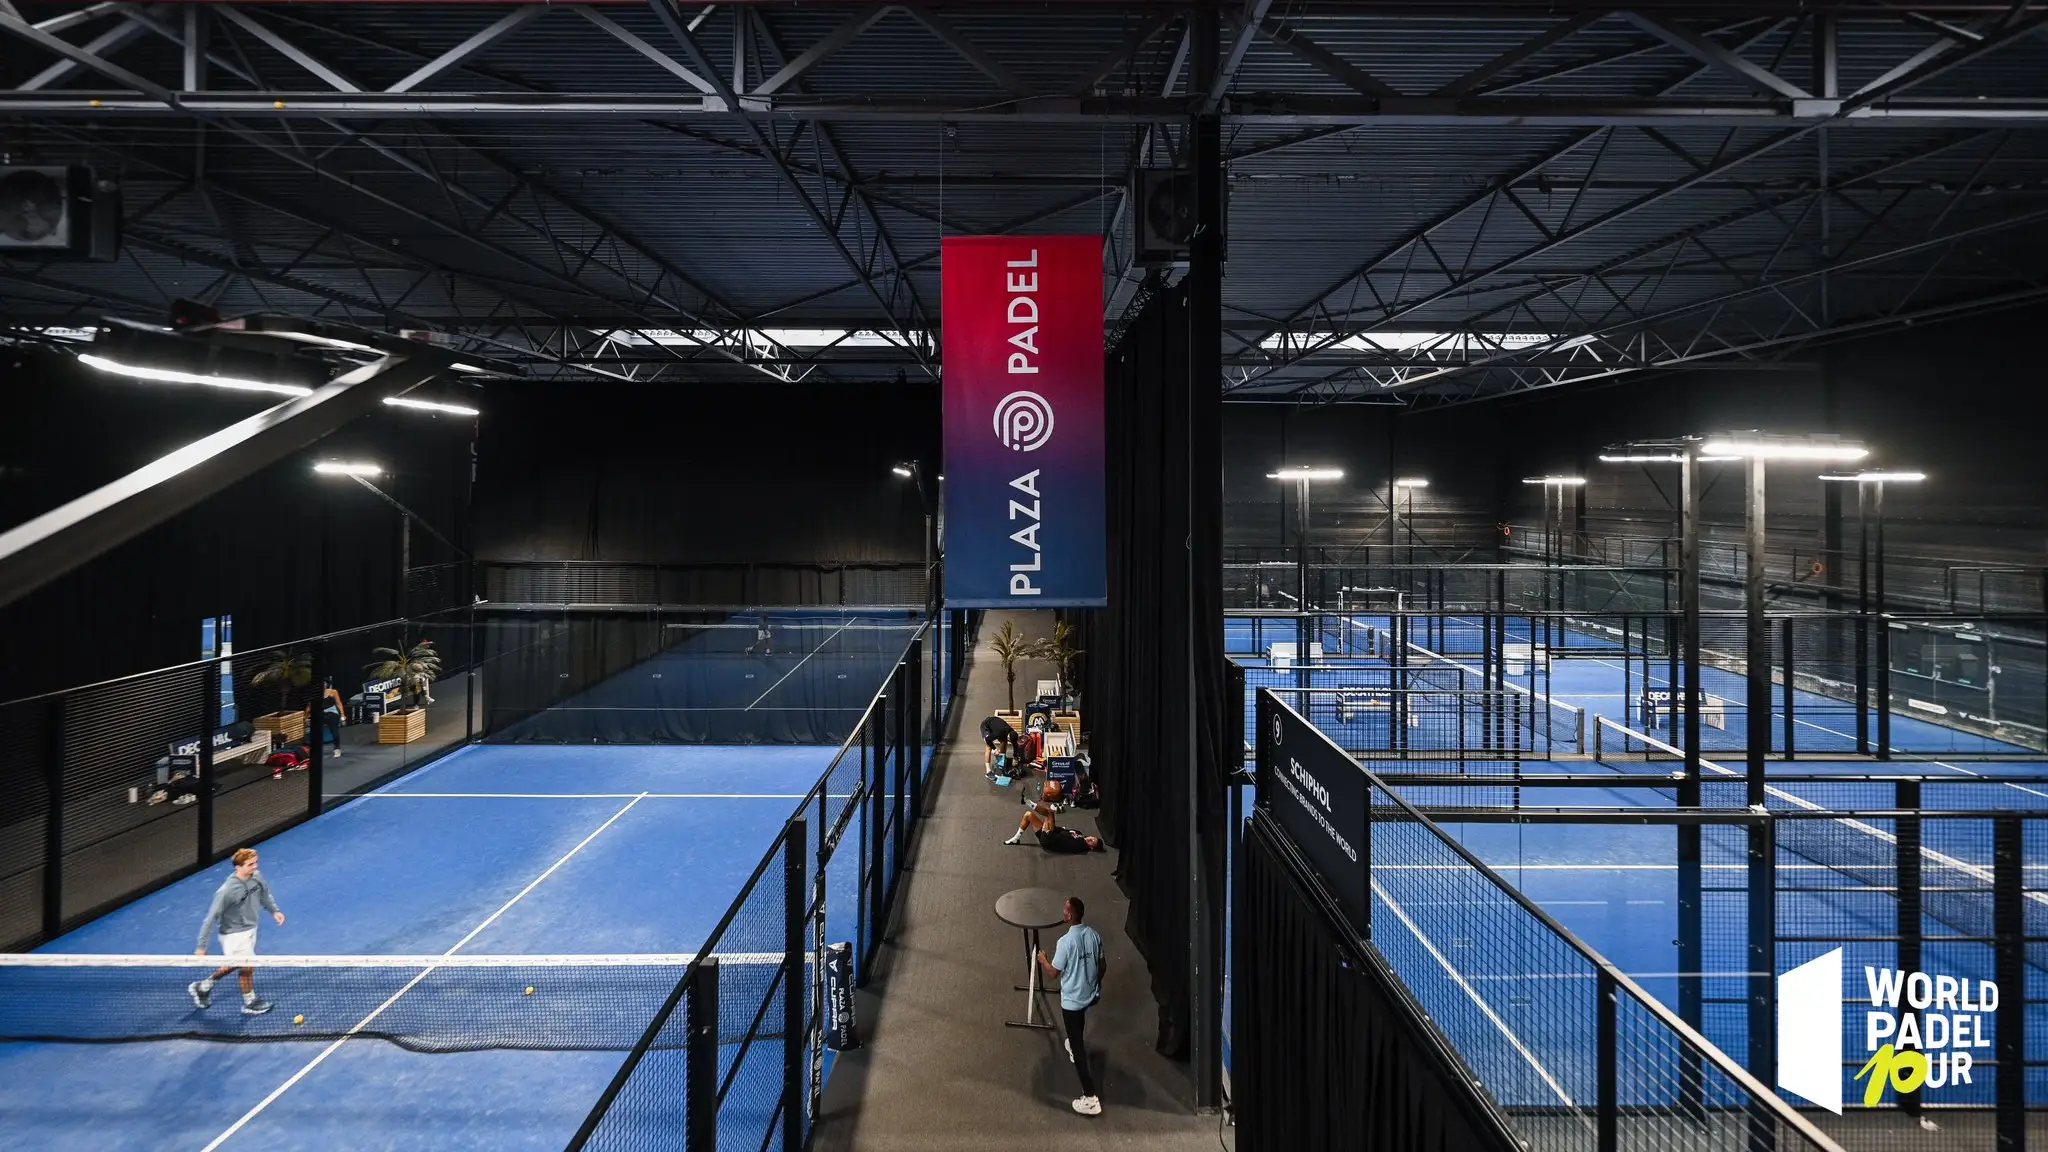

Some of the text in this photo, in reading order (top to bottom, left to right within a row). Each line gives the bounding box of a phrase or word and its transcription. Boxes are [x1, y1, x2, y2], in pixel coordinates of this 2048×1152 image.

[1007, 248, 1042, 595] PLAZA PADEL
[1275, 722, 1280, 738] 9
[1290, 757, 1332, 813] SCHIPHOL
[1274, 765, 1357, 862] CONNECTING BRANDS TO THE WORLD
[830, 976, 838, 1031] CUPRA
